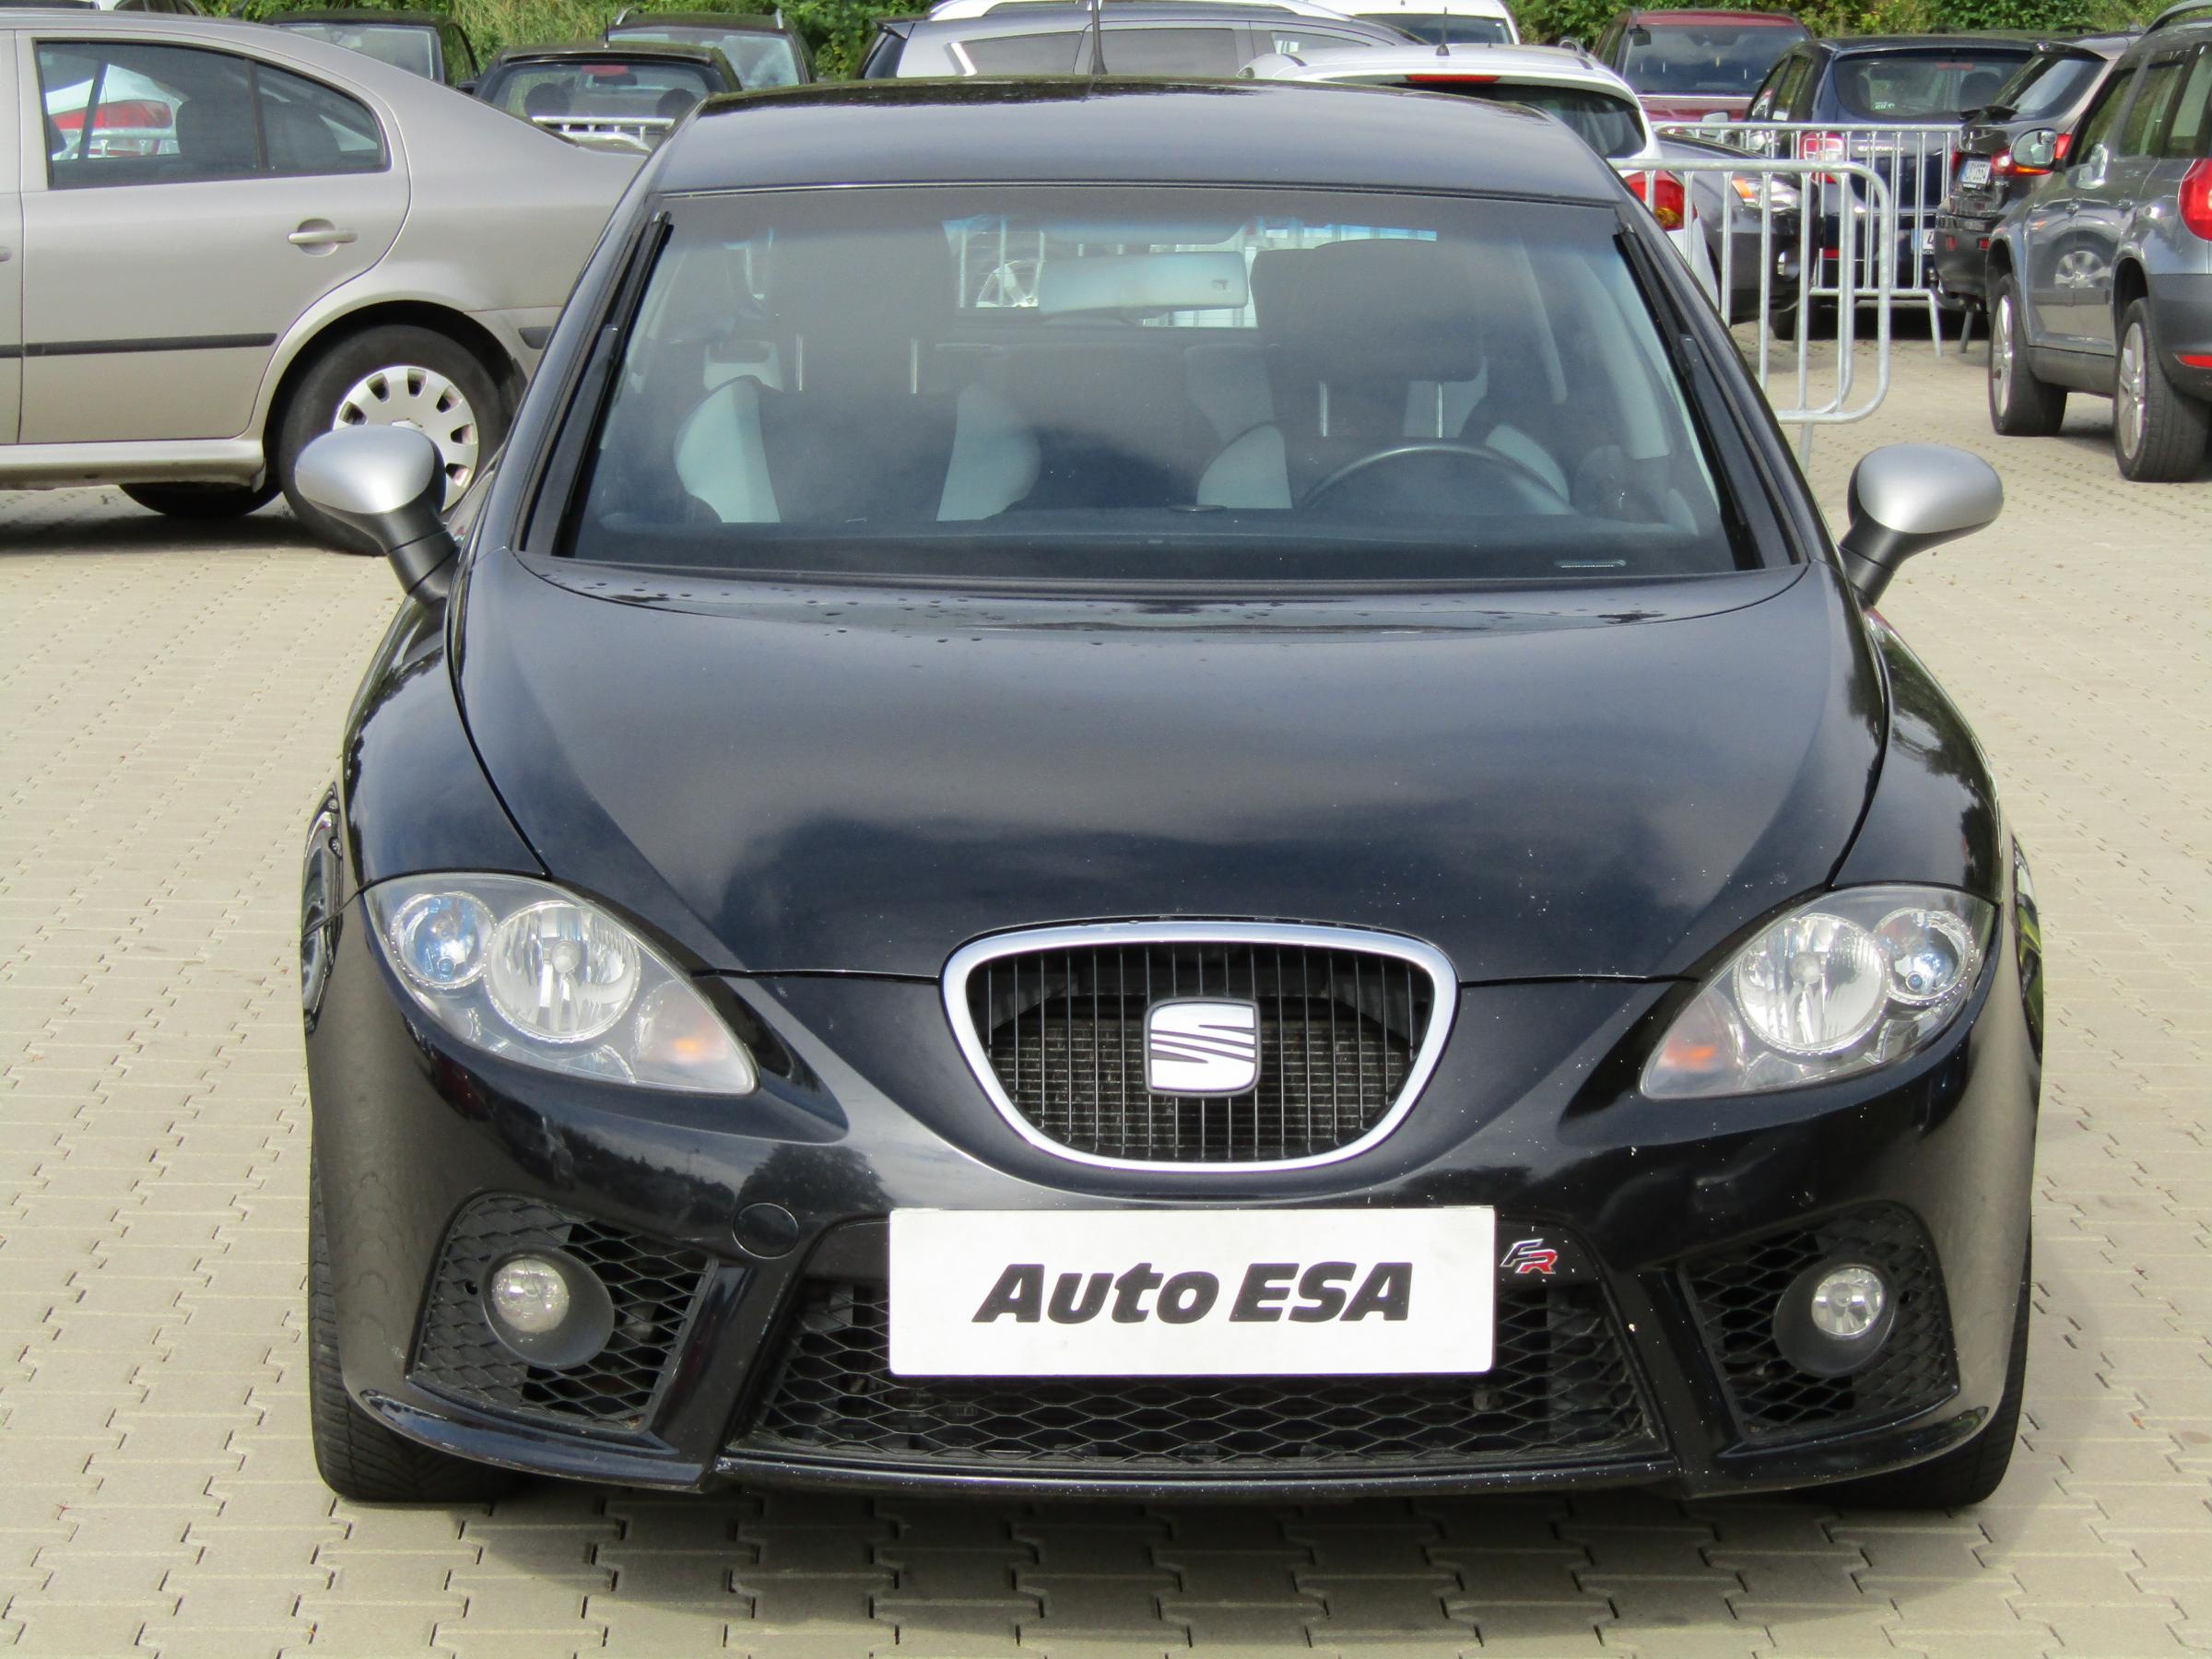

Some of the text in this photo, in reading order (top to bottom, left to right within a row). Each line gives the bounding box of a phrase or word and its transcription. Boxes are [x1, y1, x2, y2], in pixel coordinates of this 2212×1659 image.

[1500, 1239, 1557, 1275] FR
[972, 1262, 1413, 1324] Auto ESA
